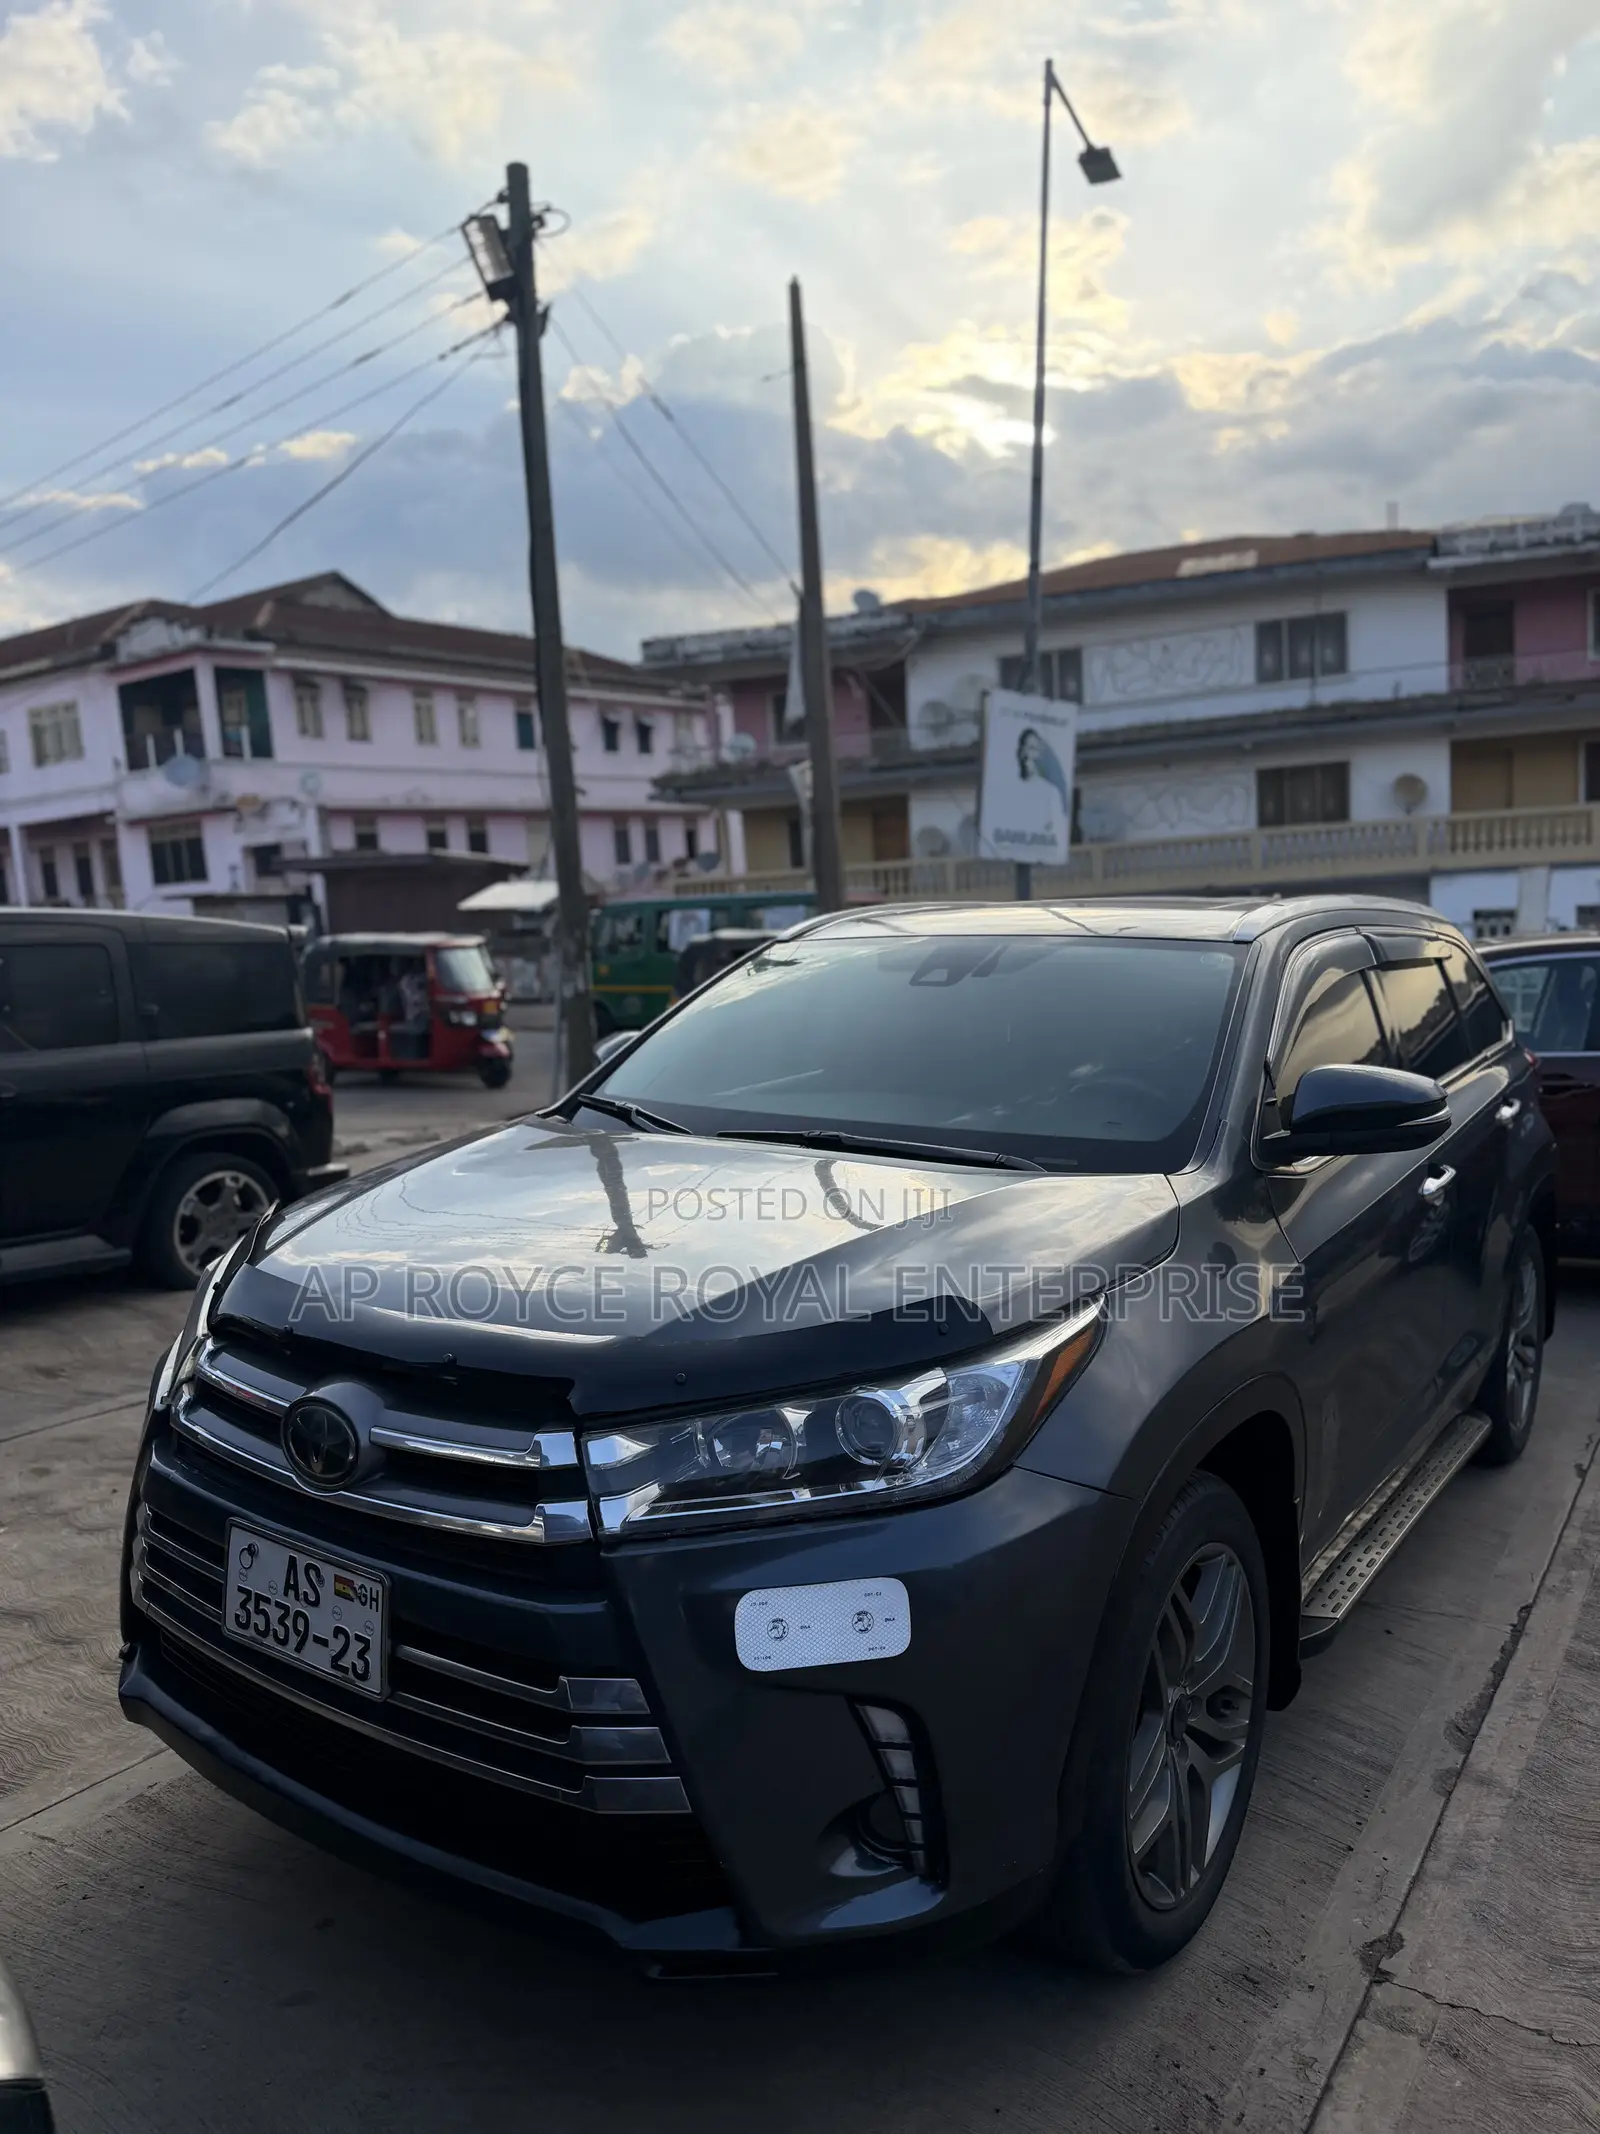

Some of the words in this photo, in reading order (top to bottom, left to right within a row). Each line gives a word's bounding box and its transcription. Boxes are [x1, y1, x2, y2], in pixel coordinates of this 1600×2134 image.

[283, 1554, 322, 1607] AS
[357, 1583, 379, 1612] GH
[234, 1584, 371, 1681] 3539-23
